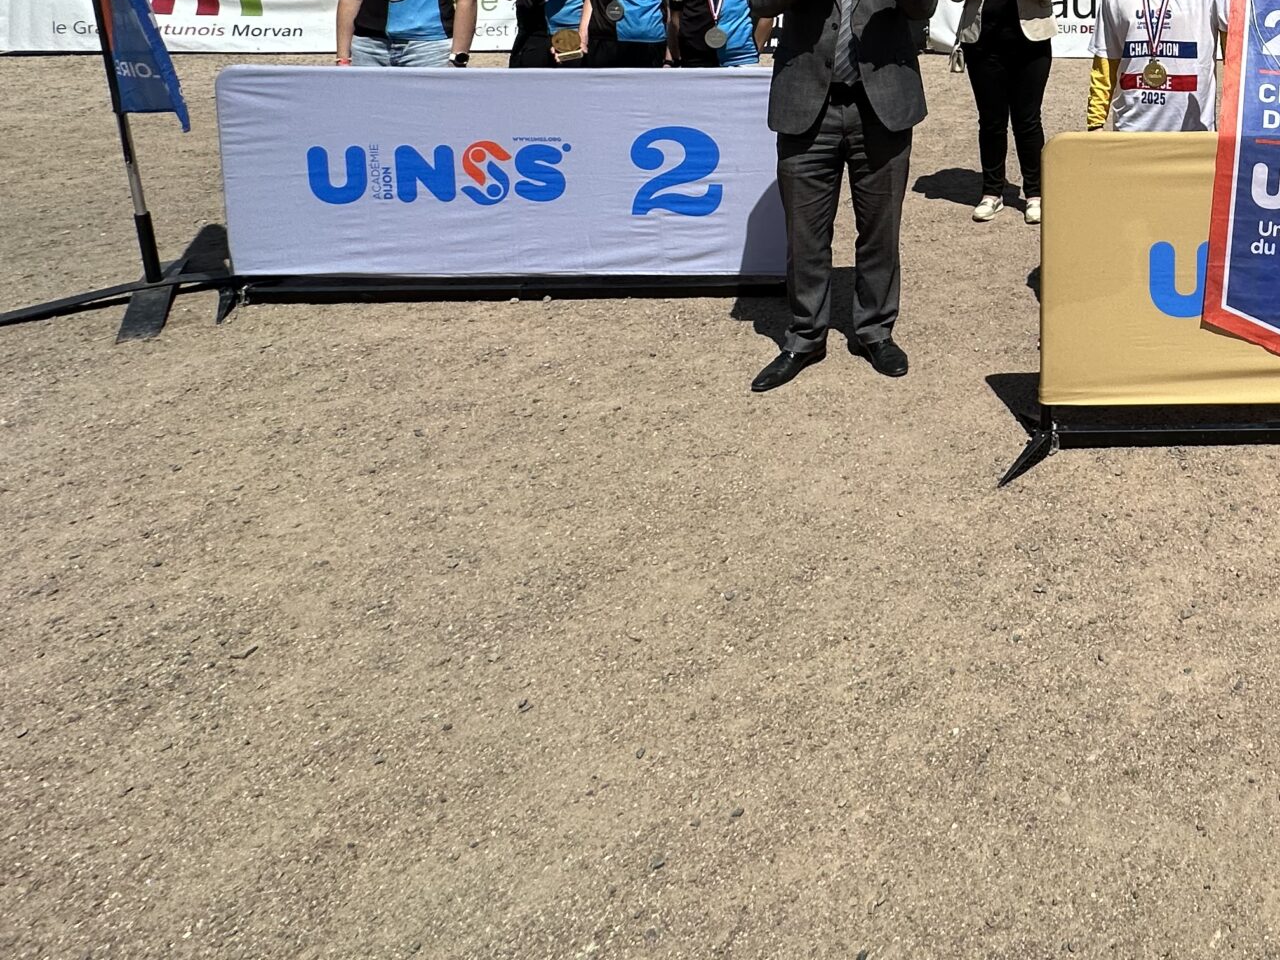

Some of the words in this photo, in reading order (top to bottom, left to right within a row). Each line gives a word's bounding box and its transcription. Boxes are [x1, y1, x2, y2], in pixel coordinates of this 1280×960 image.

[52, 20, 67, 34] le
[231, 24, 303, 38] Morvan
[1141, 92, 1166, 106] 2025
[307, 140, 566, 206] UNSS
[381, 167, 393, 200] DIJON
[630, 126, 723, 217] 2
[1250, 239, 1276, 256] du
